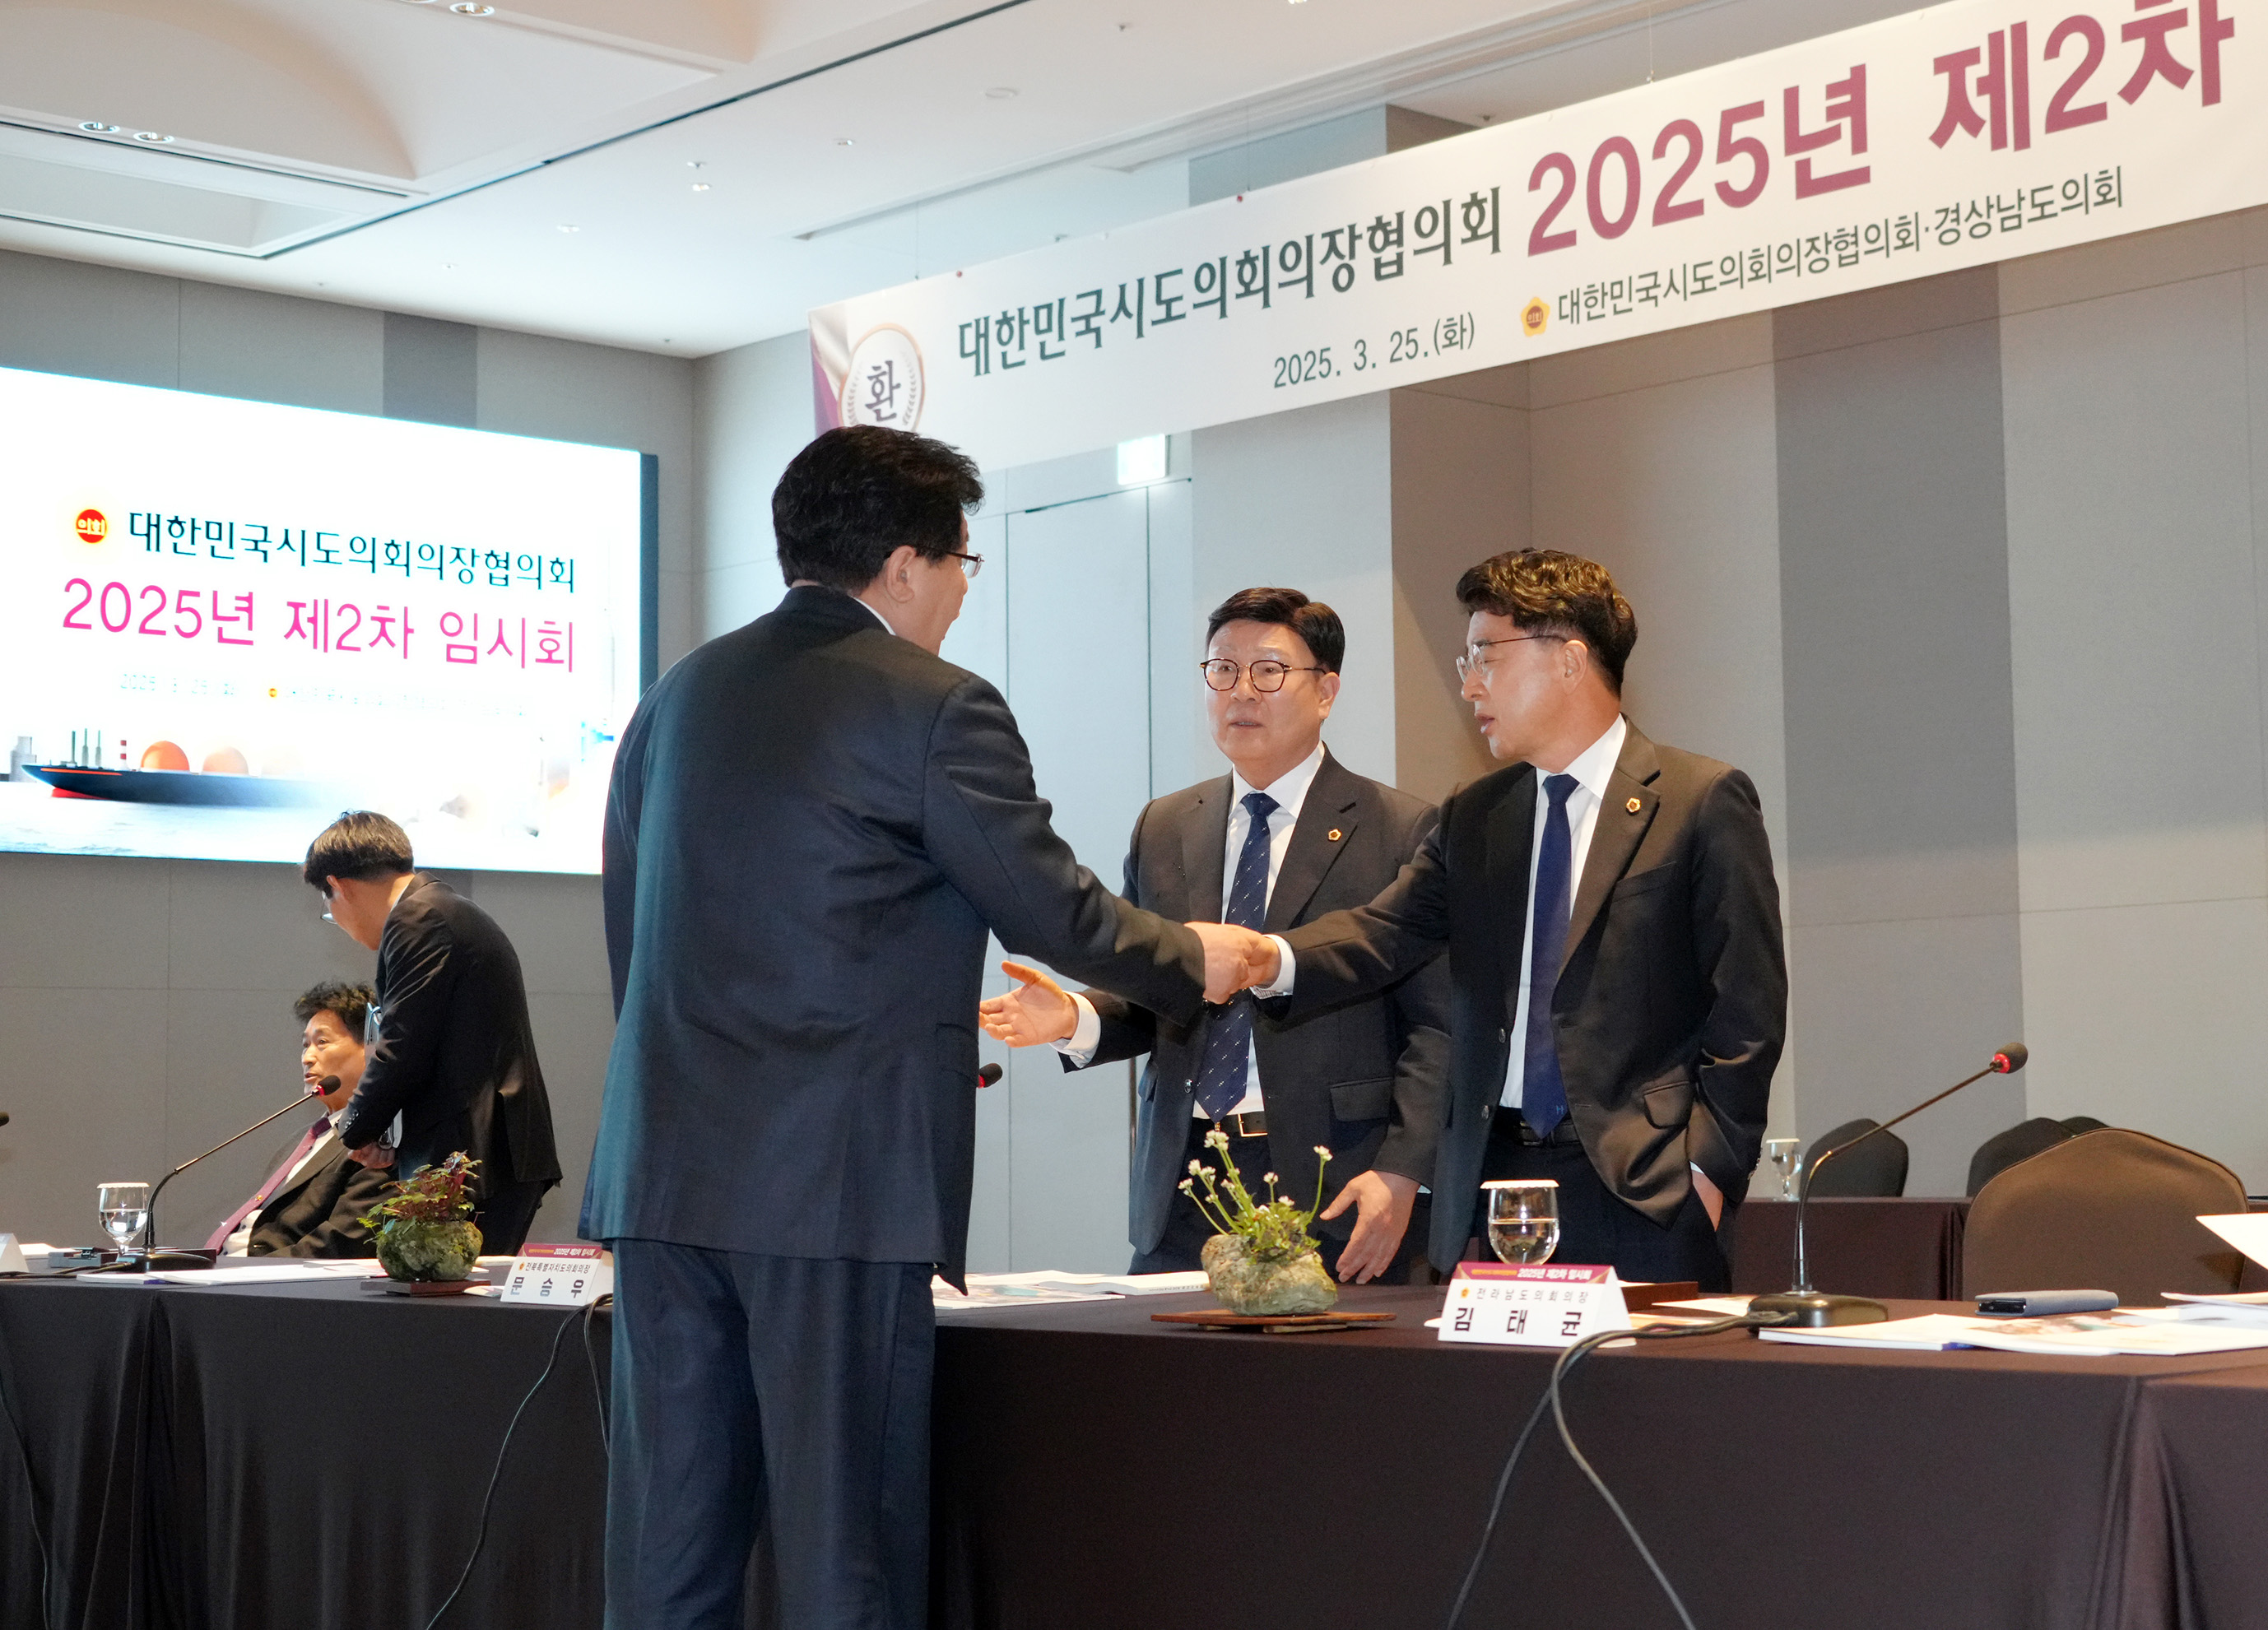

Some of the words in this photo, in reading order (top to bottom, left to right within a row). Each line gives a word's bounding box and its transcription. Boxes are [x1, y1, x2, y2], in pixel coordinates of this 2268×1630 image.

[958, 185, 1501, 377] 대한민국시도의회의장협의회
[1527, 63, 1871, 257] 2025년
[1929, 0, 2235, 152] 제2차
[865, 360, 901, 422] 환
[1274, 346, 1341, 388] 2025.
[1354, 339, 1377, 371] 3.
[129, 511, 576, 592] 대한민국시도의회의장협의회
[63, 577, 255, 646] 2025년
[283, 598, 414, 659] 제2차
[439, 610, 574, 672] 임시회
